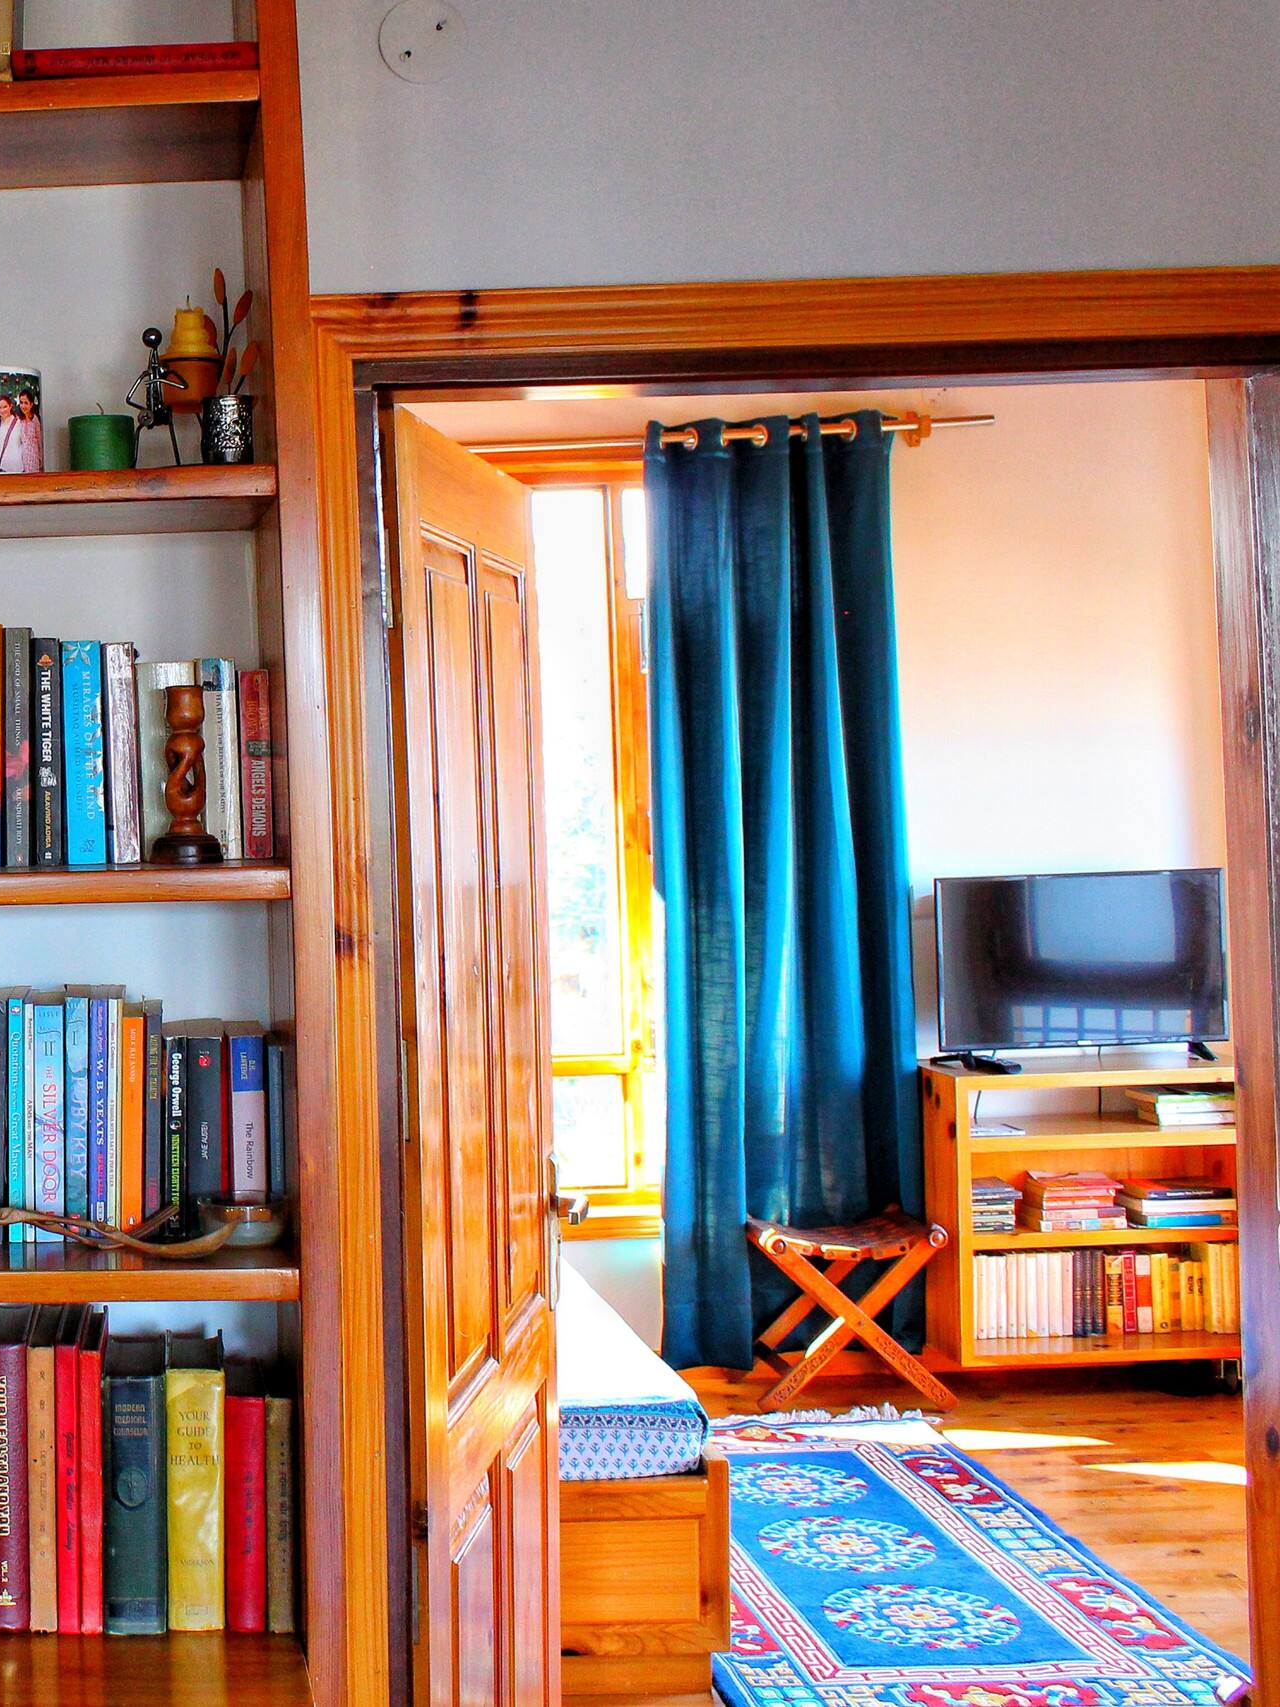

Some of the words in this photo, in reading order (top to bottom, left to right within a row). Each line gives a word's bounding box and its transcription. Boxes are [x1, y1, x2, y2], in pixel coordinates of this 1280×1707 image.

[40, 670, 50, 691] THE
[41, 694, 51, 729] WHITE
[81, 671, 92, 727] MIRAGES
[246, 701, 256, 736] BROWN
[42, 732, 52, 762] TIGER
[84, 732, 93, 747] OF
[251, 760, 265, 794] ANGELS
[85, 785, 95, 819] MIND
[252, 798, 266, 836] DEMONS
[10, 1032, 21, 1086] Quotations
[96, 1058, 104, 1076] W.
[170, 1053, 182, 1085] George
[96, 1081, 104, 1094] B.
[171, 1087, 182, 1116] Orwell
[11, 1112, 21, 1140] Great
[42, 1084, 57, 1144] SILVER
[96, 1099, 104, 1146] YEATS
[245, 1122, 253, 1138] The
[11, 1143, 21, 1181] Masters
[172, 1134, 180, 1166] NINETEEN
[246, 1141, 254, 1179] Rainbow
[43, 1150, 57, 1203] DOOR
[179, 1411, 209, 1420] YOUR
[189, 1442, 202, 1450] TO
